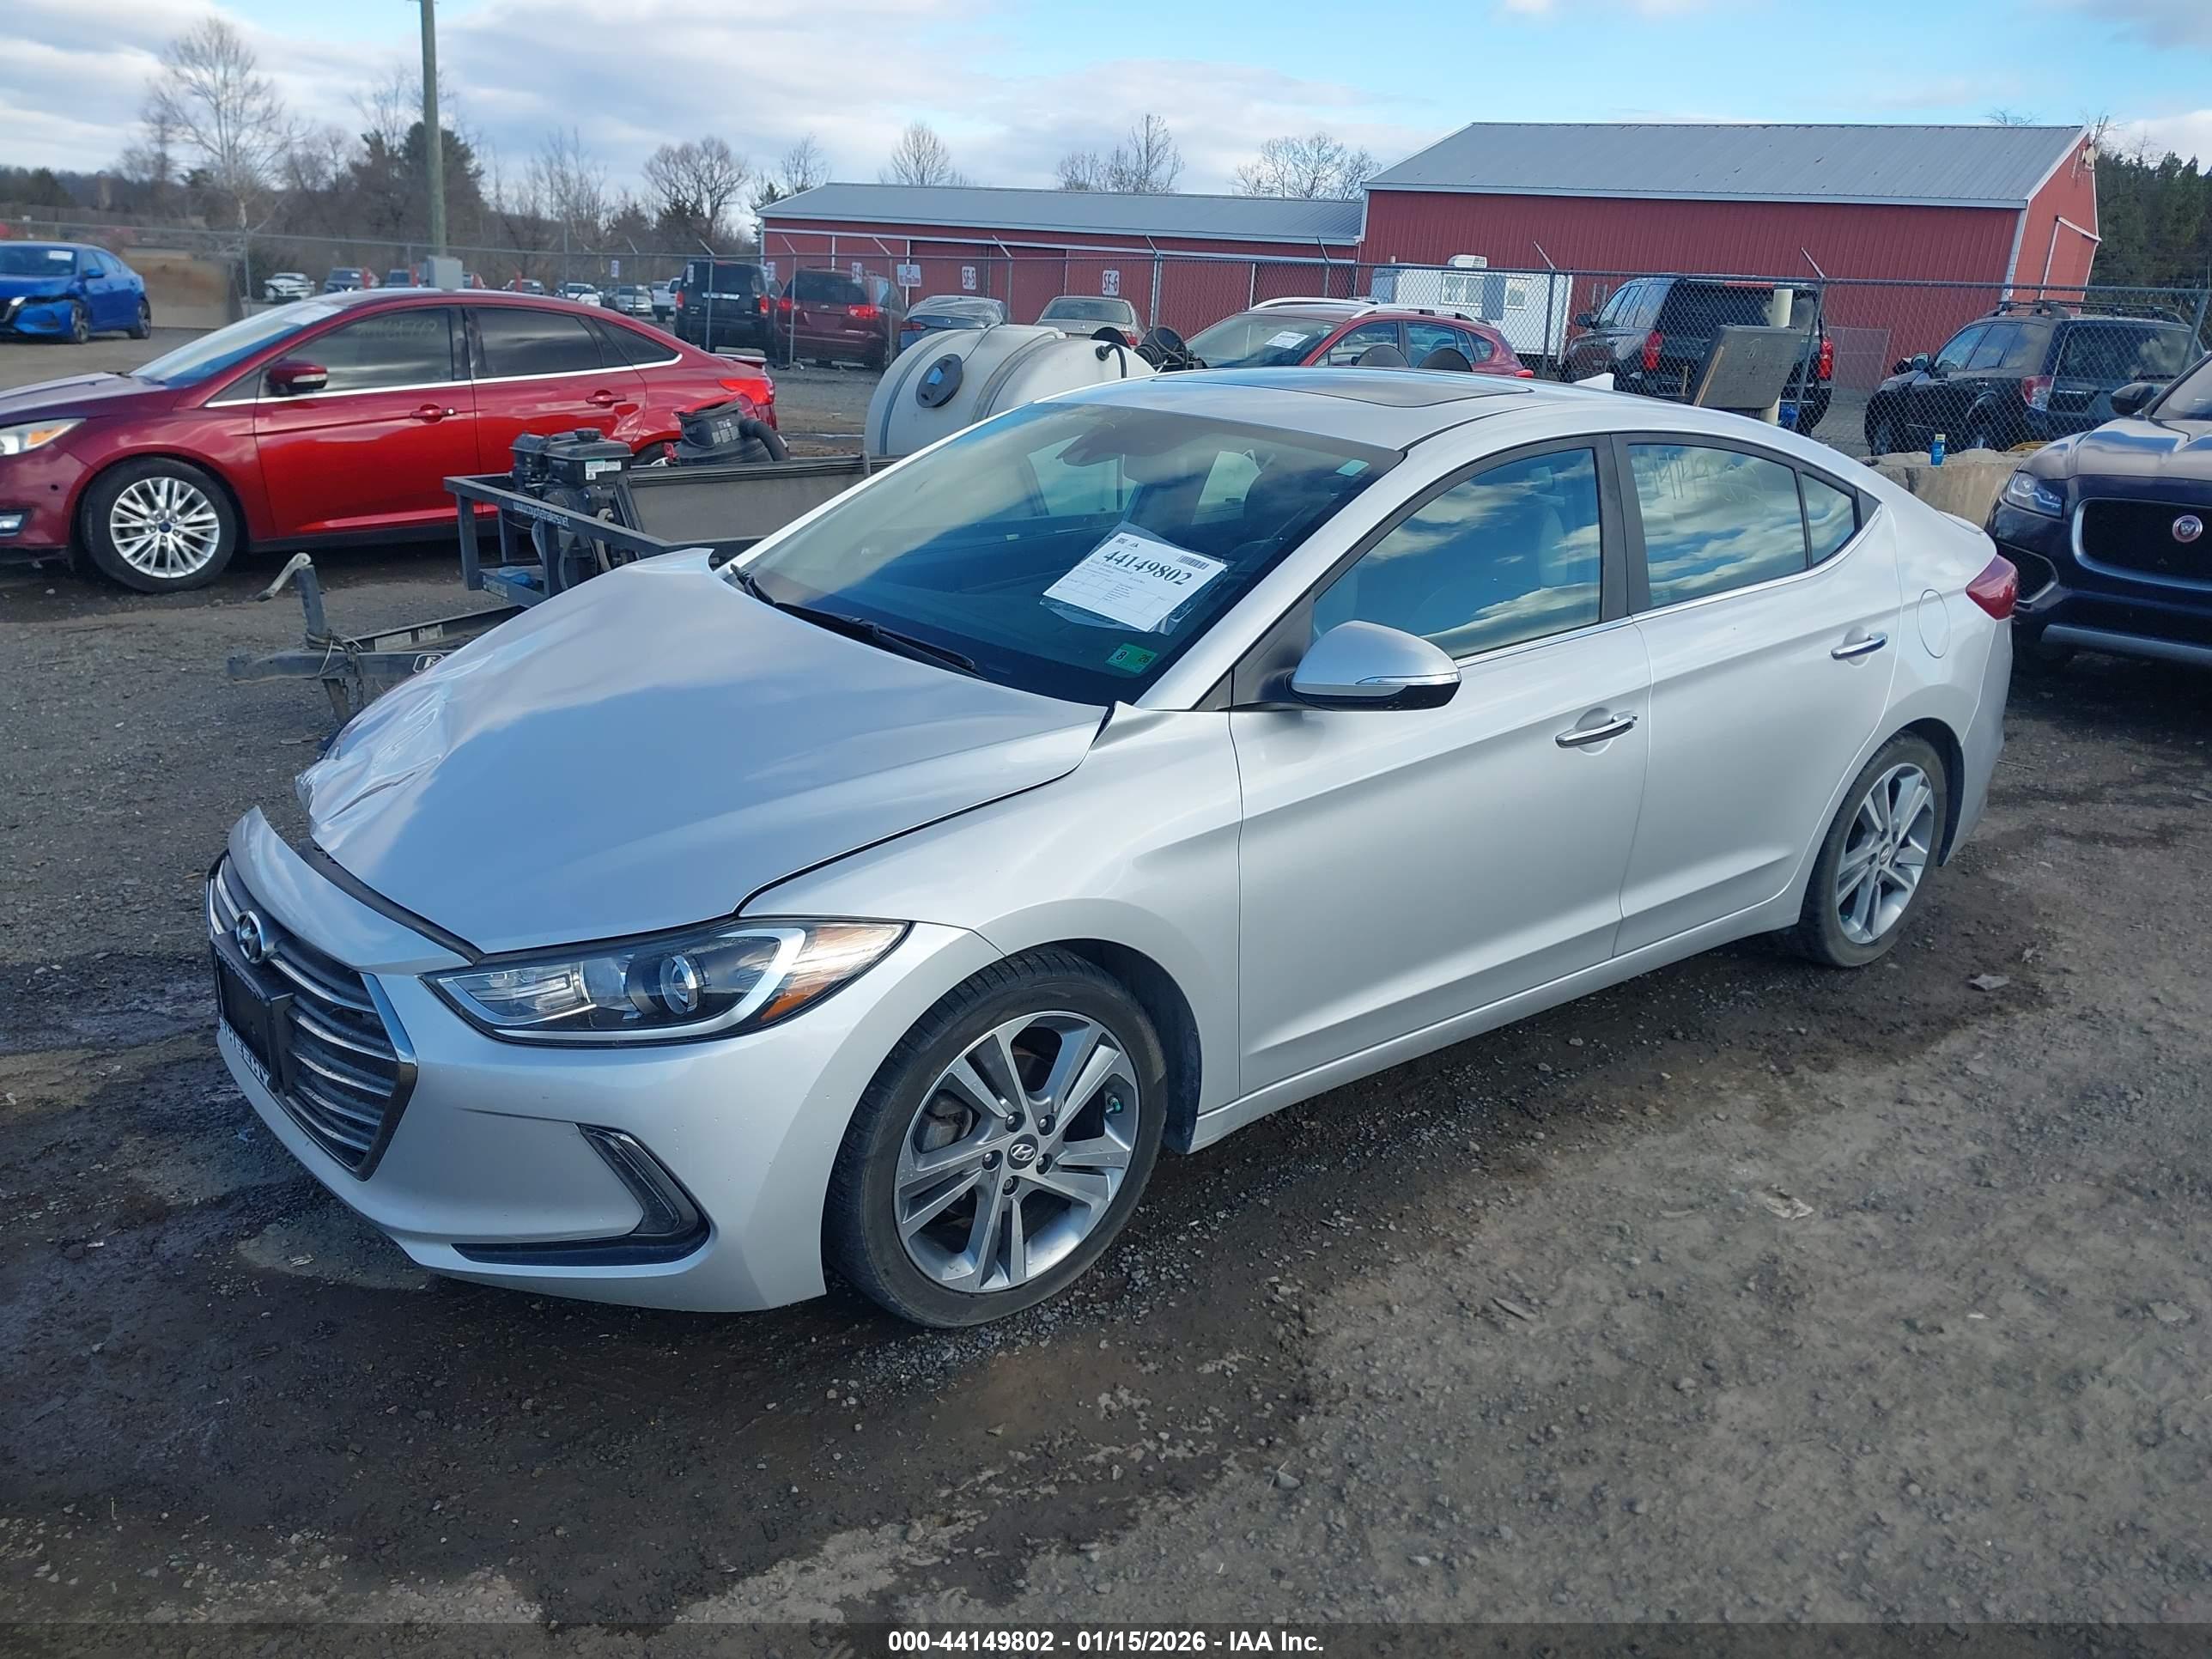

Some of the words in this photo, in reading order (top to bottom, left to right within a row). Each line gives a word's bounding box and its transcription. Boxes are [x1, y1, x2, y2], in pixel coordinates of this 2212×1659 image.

[1103, 273, 1119, 293] SF-6
[1103, 550, 1193, 586] 44149802
[1116, 651, 1127, 660] 8
